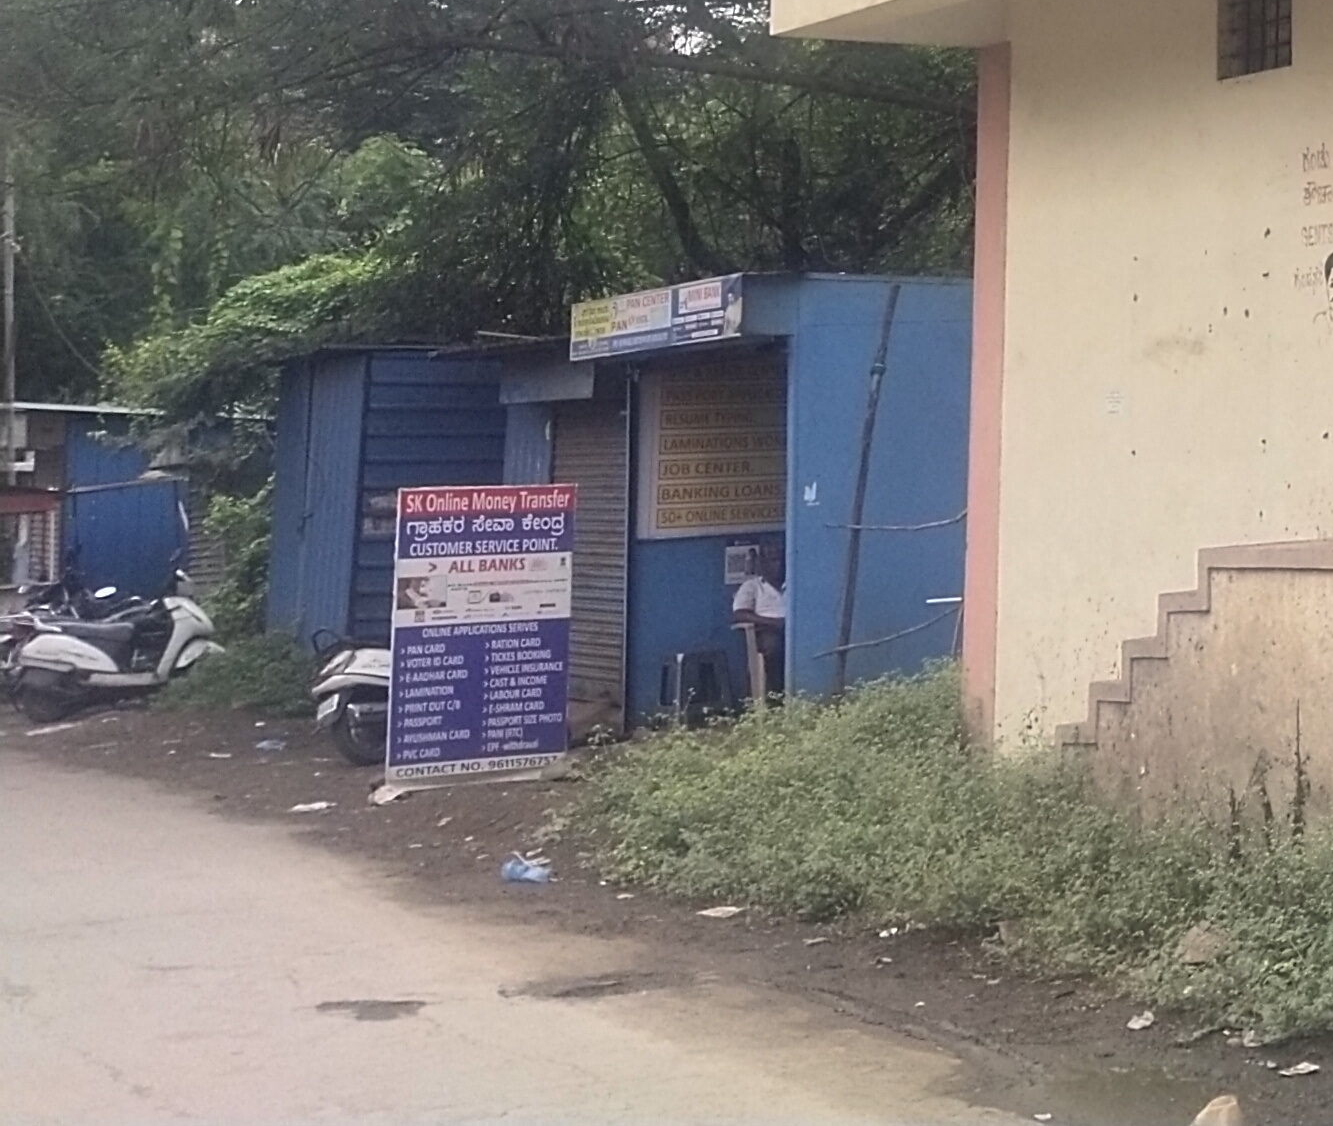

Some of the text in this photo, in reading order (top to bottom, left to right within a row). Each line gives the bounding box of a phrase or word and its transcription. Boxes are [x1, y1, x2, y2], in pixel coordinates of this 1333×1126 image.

[665, 412, 709, 427] RESUME
[664, 436, 748, 451] LAMINATIONS
[662, 463, 691, 477] JOB
[661, 486, 730, 501] BANKING
[406, 488, 571, 514] SK Online Money Transfer
[661, 512, 683, 525] 50+
[686, 509, 727, 524] ONLINE
[406, 512, 565, 541] ಗ್ರಾಹಕರ ಸೇವಾ ಕೇಂದ್ರ
[410, 537, 559, 557] CUSTOMER SERVICE POINT.
[448, 557, 526, 574] ALL BANKS
[422, 621, 539, 638] ONLINE APPLICATIONS SERIVES
[406, 643, 446, 655] PAN CARD
[491, 637, 541, 650] RATION CARD
[406, 655, 464, 668] VOTER ID CARD
[517, 649, 552, 661] BOOKING
[446, 669, 468, 680] CARD
[490, 661, 563, 676] VEHICLE INSURANCE
[489, 675, 548, 688] CAST & INCOME
[405, 685, 454, 698] LAMINATION
[489, 687, 542, 700] LABOUR CARD
[405, 702, 428, 713] PRINT
[428, 701, 446, 712] OUT
[488, 700, 545, 714] E-SHRAM CARD
[403, 715, 443, 727] PASSPORT
[487, 712, 563, 727] PASSPORT SIZE PHOTO
[403, 728, 471, 744] AYUSHMAN CARD
[402, 747, 440, 760] PVC CARD
[487, 742, 500, 752] EPF
[396, 763, 456, 778] CONTACT
[460, 761, 484, 772] NO.
